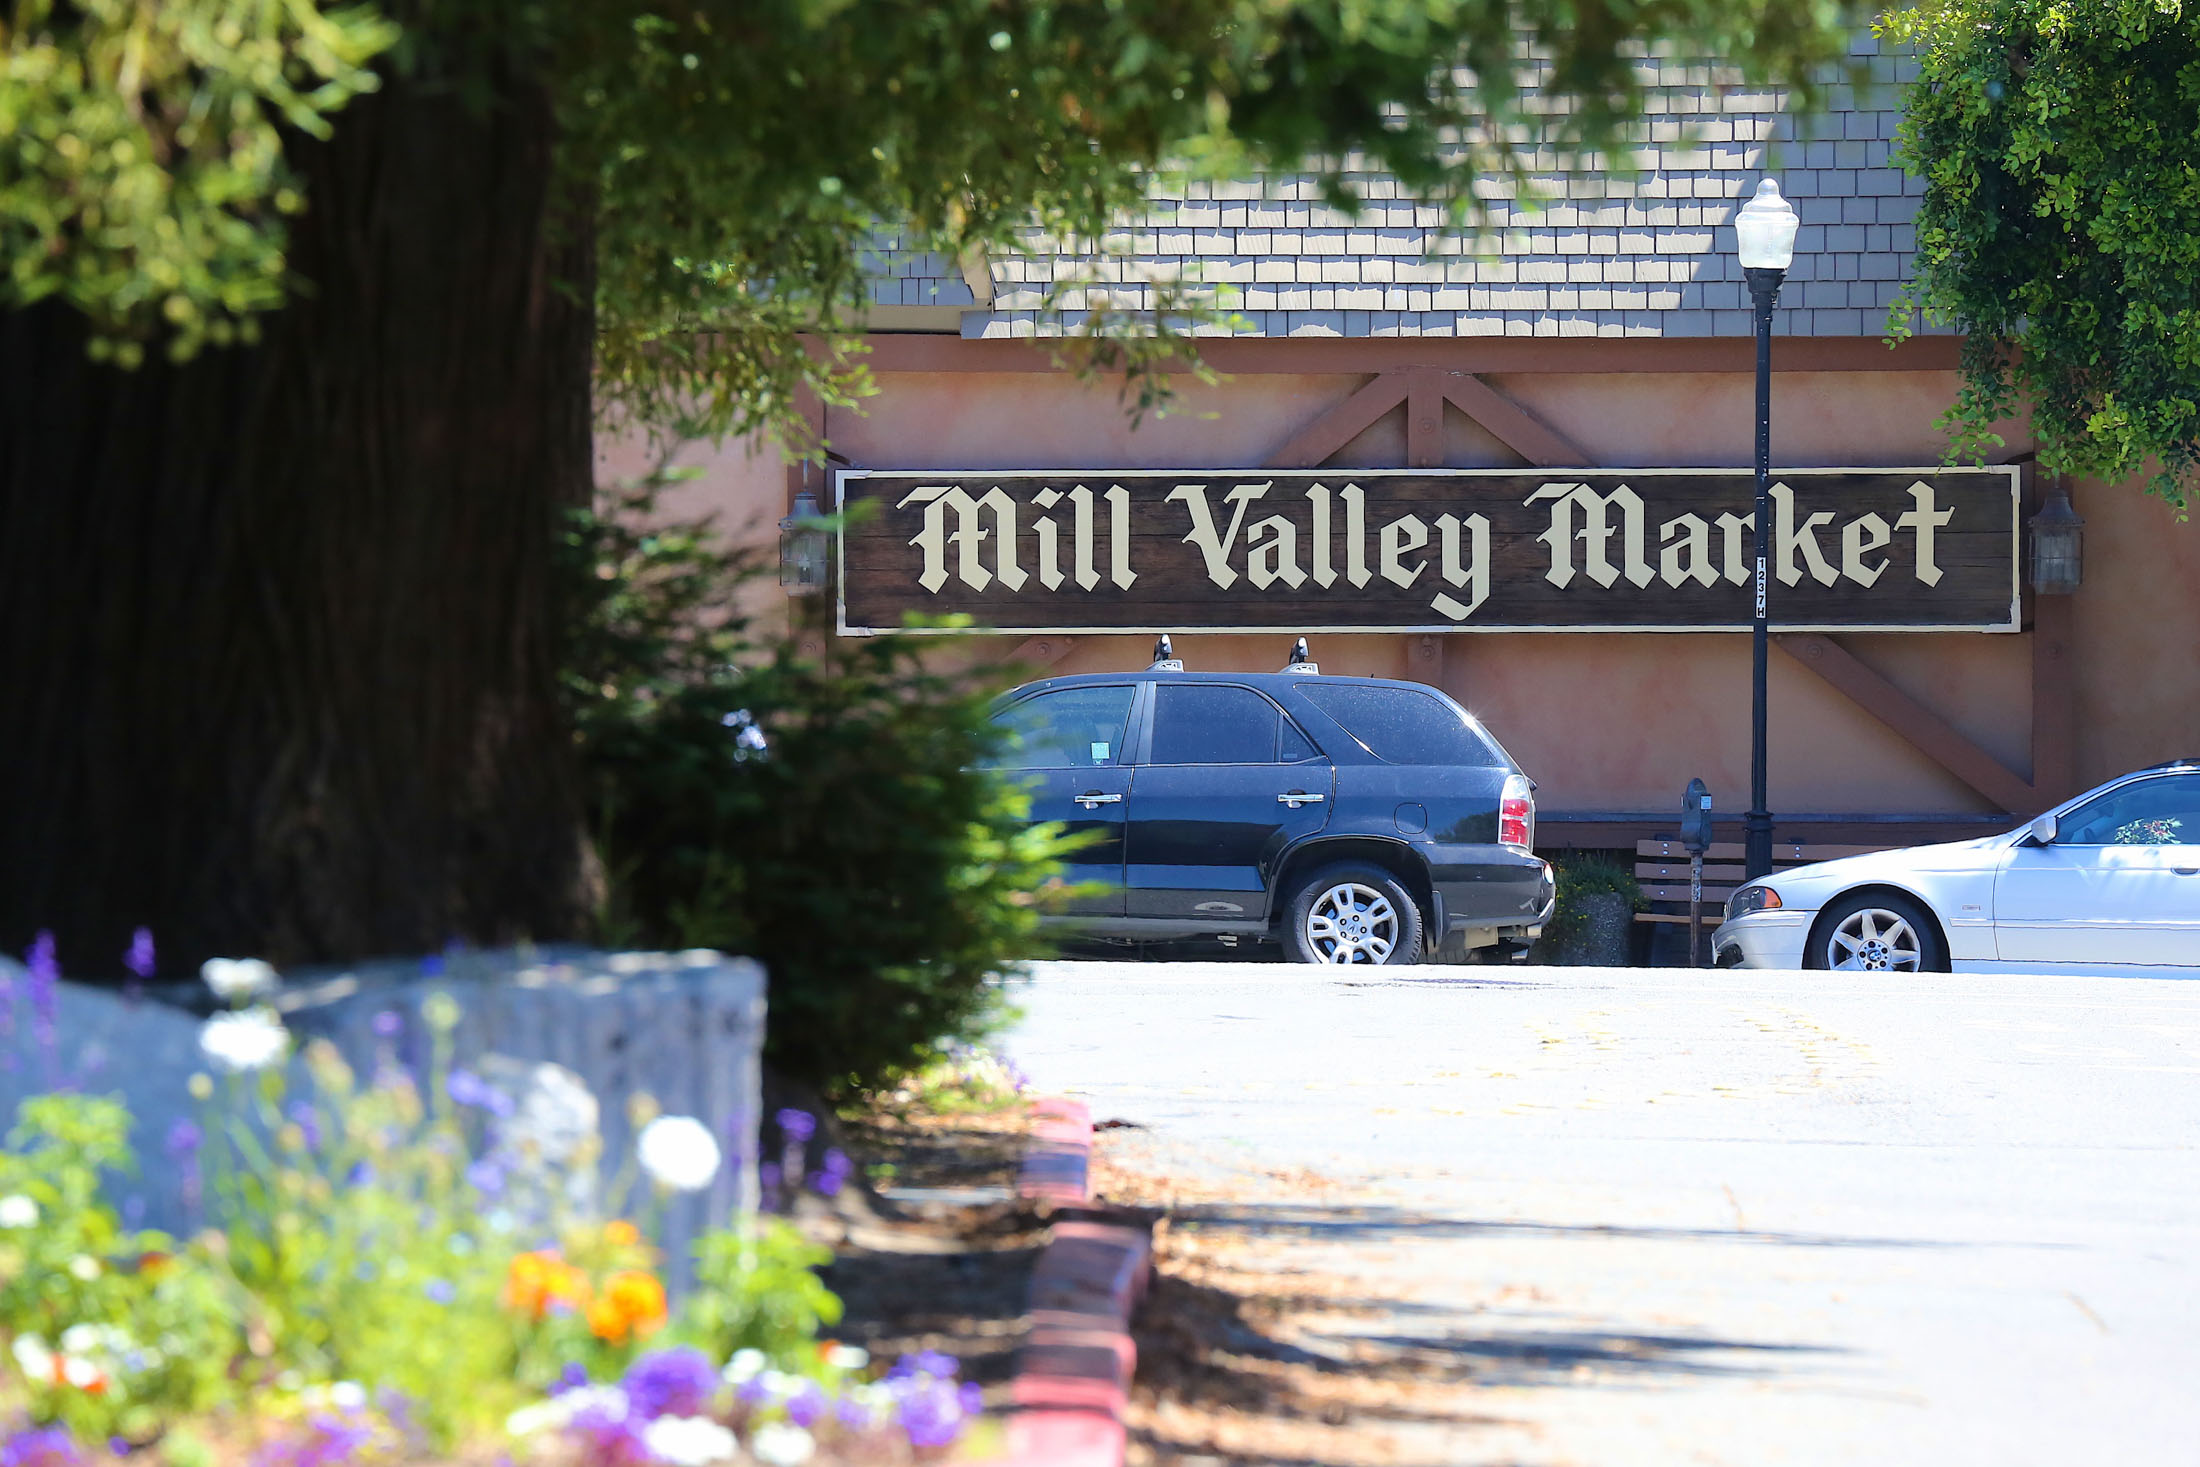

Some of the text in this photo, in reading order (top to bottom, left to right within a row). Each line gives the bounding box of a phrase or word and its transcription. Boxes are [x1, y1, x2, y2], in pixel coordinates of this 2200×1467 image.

[896, 480, 1956, 620] Mill Valley Market
[1757, 558, 1765, 617] 1237H
